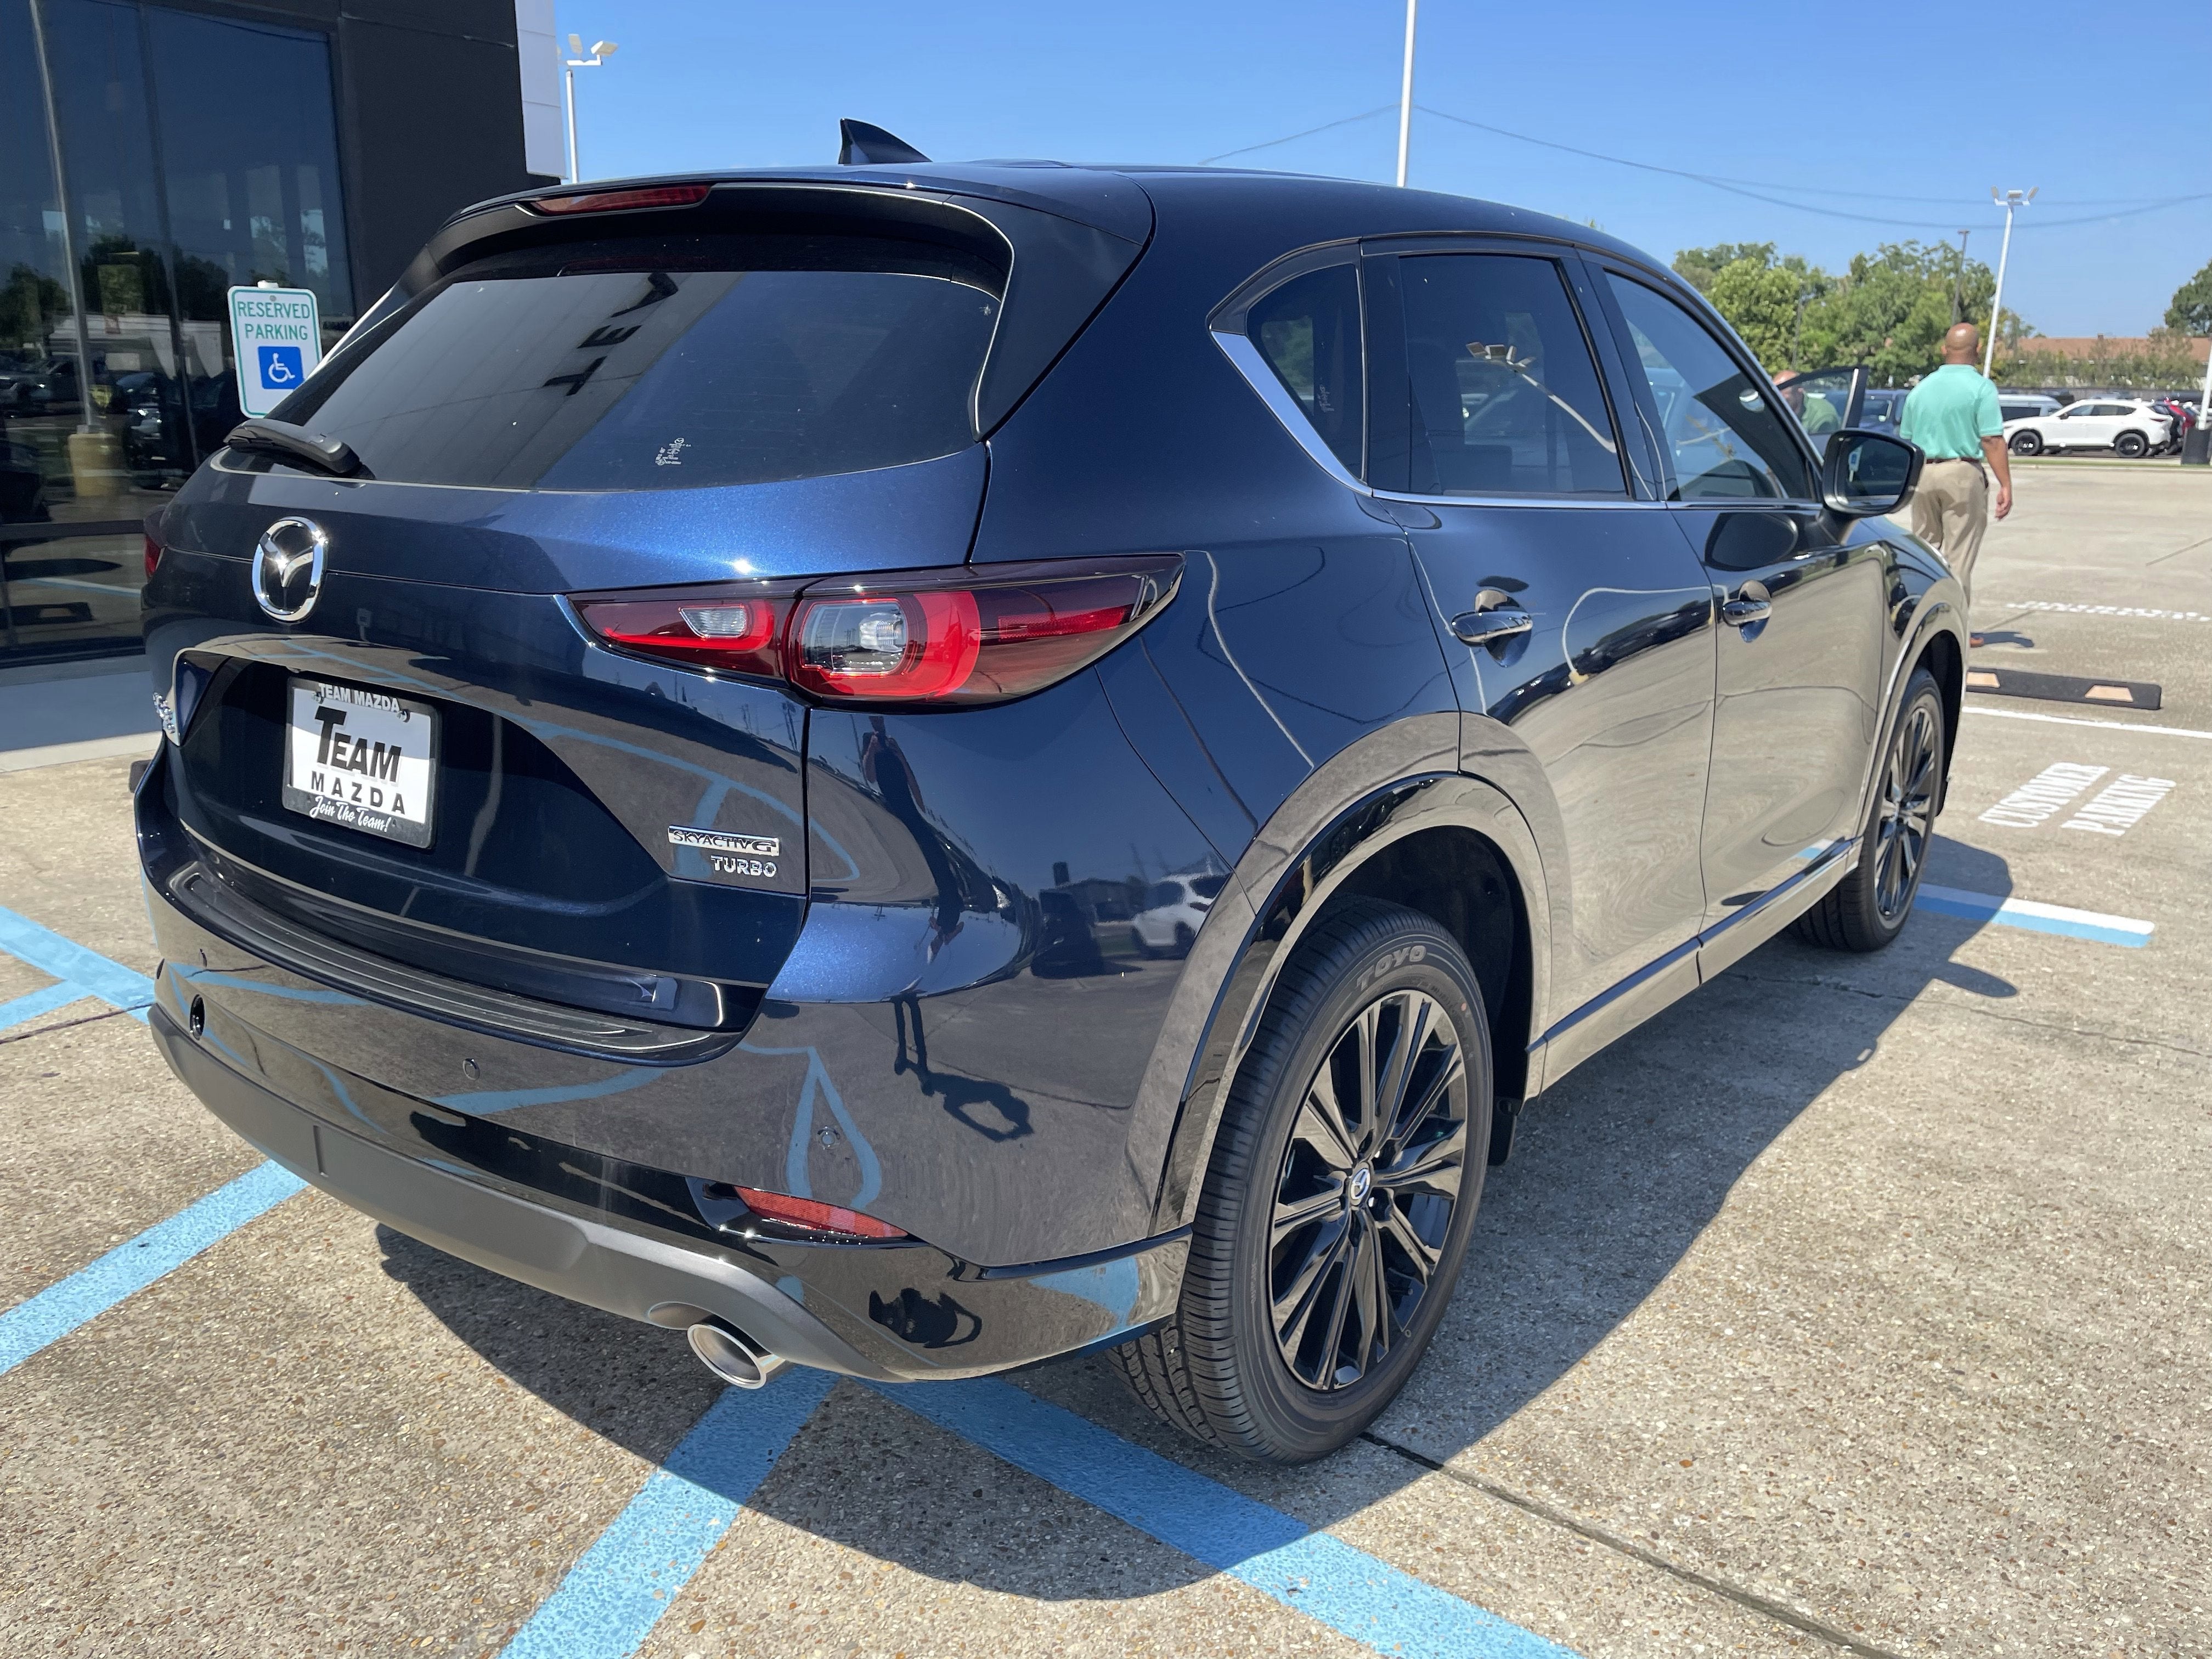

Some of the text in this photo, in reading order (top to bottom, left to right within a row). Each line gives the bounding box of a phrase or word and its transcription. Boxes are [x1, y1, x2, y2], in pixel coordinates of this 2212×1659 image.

[237, 301, 310, 319] RESERVED
[244, 323, 308, 340] PARKING
[319, 682, 400, 713] TEAM MAZDA
[314, 706, 402, 783] TEAM
[311, 770, 405, 815] MAZDA
[1978, 761, 2111, 828] CUSTOMER
[2061, 774, 2177, 837] PARKING
[309, 795, 392, 833] Join The Team!
[710, 855, 777, 878] TURBO
[1356, 945, 1426, 991] TOYO
